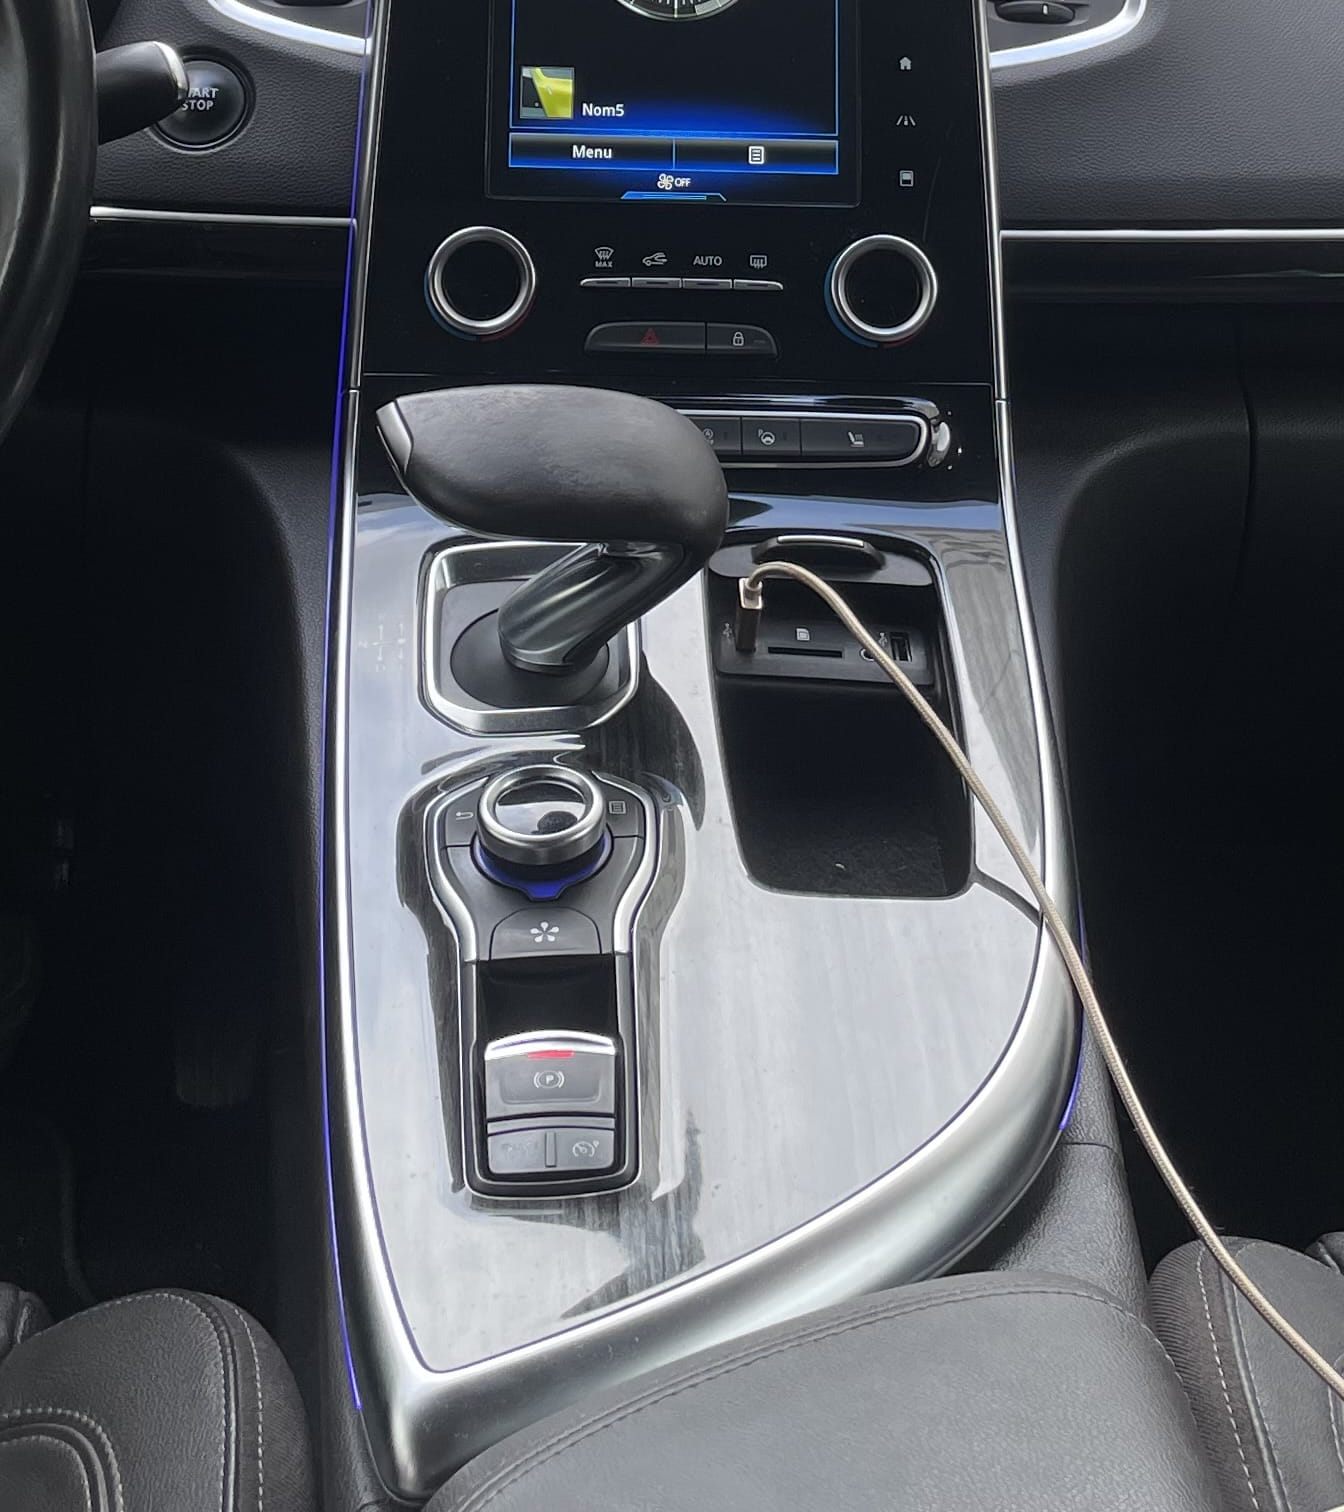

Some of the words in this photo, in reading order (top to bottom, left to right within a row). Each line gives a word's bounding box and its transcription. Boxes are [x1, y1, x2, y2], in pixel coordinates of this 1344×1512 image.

[581, 102, 625, 118] Nom5
[572, 144, 613, 160] Menu
[674, 176, 692, 188] OFF
[594, 260, 613, 268] MAX
[692, 254, 723, 267] AUTO
